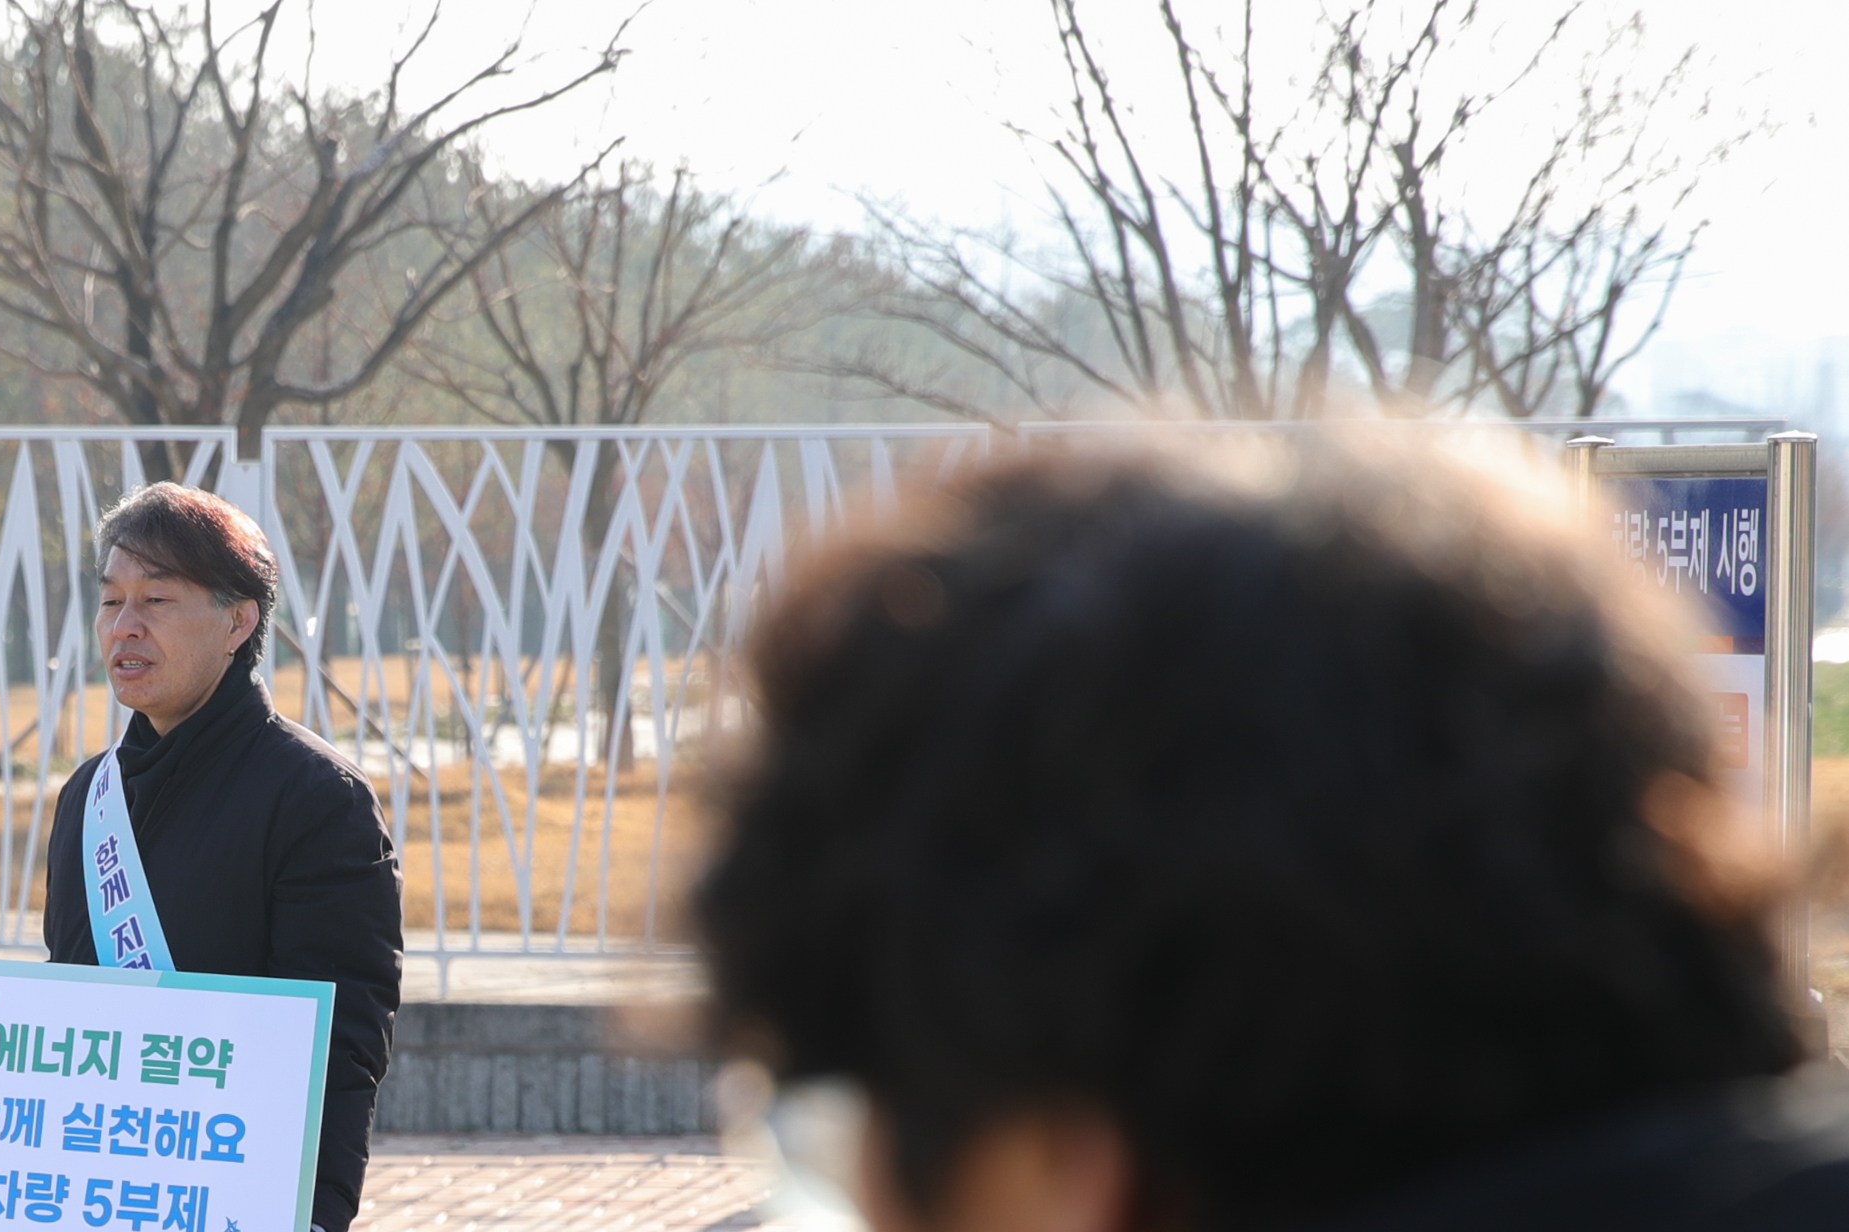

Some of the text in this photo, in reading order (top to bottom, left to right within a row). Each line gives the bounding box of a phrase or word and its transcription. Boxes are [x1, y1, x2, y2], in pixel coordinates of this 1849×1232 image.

[1657, 508, 1710, 595] 5부제
[1716, 508, 1760, 597] 시행
[95, 835, 130, 914] 함께
[139, 1033, 234, 1089] 절약
[61, 1101, 246, 1164] 실천해요
